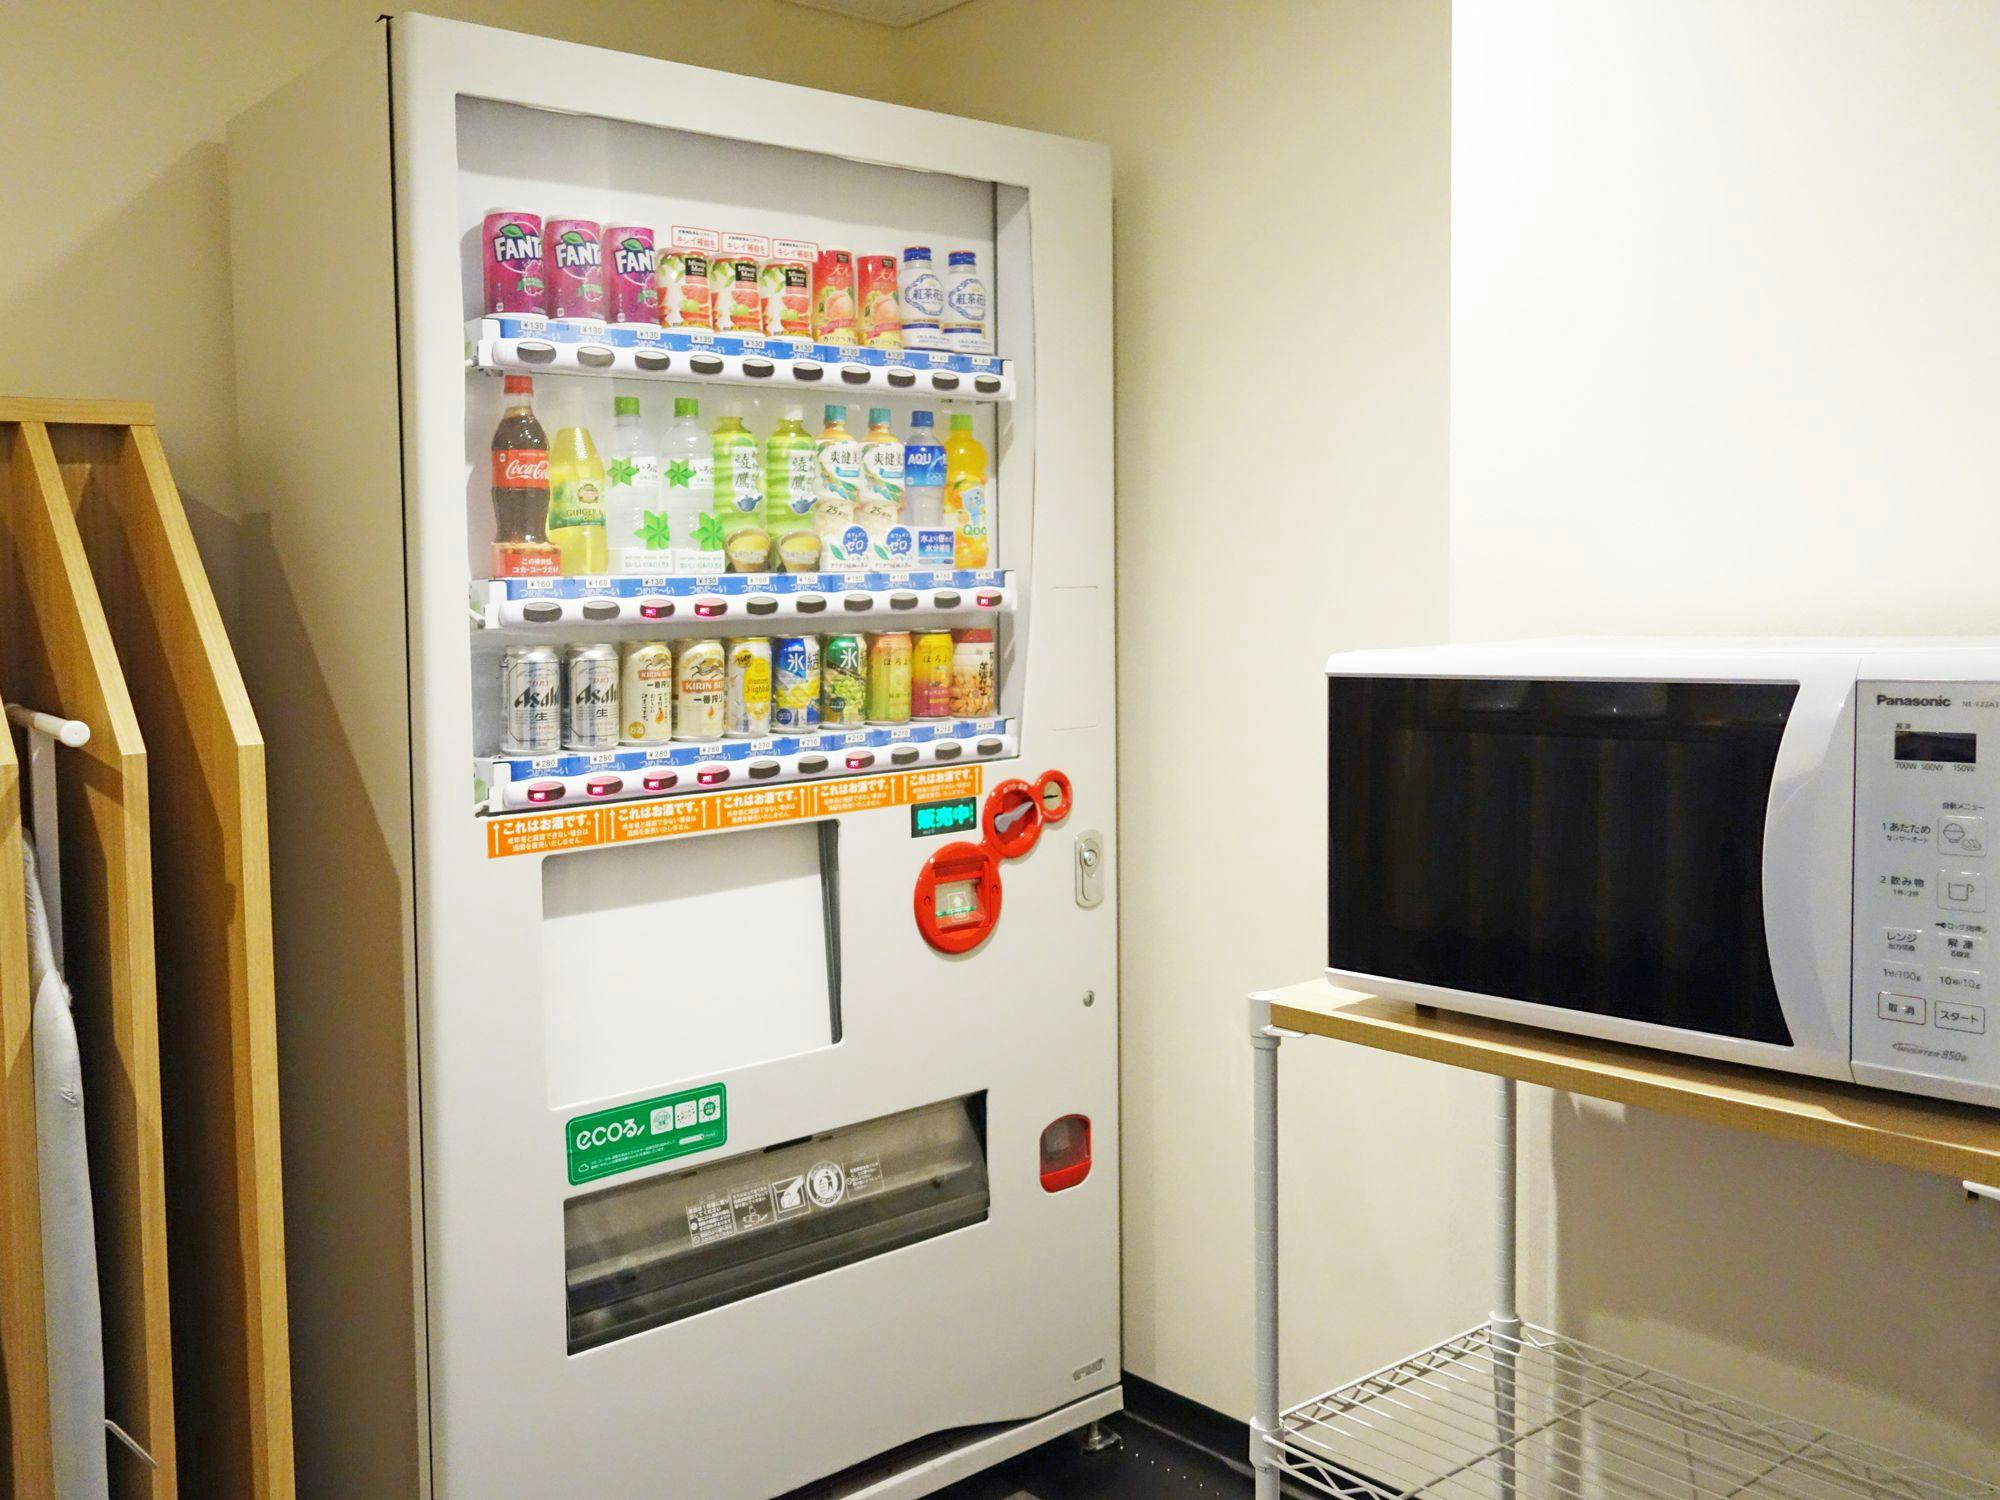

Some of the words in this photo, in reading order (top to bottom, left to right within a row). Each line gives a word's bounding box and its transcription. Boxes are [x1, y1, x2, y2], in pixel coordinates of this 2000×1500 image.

[555, 242, 600, 269] FANT
[615, 249, 655, 275] FANT
[583, 327, 602, 335] ¥130
[575, 683, 618, 705] Asah
[685, 682, 712, 691] KIRIN
[514, 684, 560, 708] Asah
[1877, 694, 1951, 707] Panasonic
[535, 712, 548, 721] 生
[596, 709, 608, 718] 生
[535, 760, 556, 768] ¥280
[1896, 762, 1917, 770] 700W
[1921, 763, 1944, 771] 500W
[1953, 764, 1976, 772] 150W
[910, 768, 972, 786] これはお酒です。
[820, 777, 889, 796] これはお酒です。
[724, 789, 798, 809] これはお酒です。
[618, 801, 699, 821] これはお酒です。
[918, 804, 970, 830] 販売中
[503, 814, 592, 835] これはお酒です。
[1889, 822, 1931, 835] あたため
[1880, 875, 1887, 884] 2
[1890, 875, 1925, 888] 飲み物
[1887, 931, 1918, 943] レンジ
[1941, 1010, 1980, 1025] スタート
